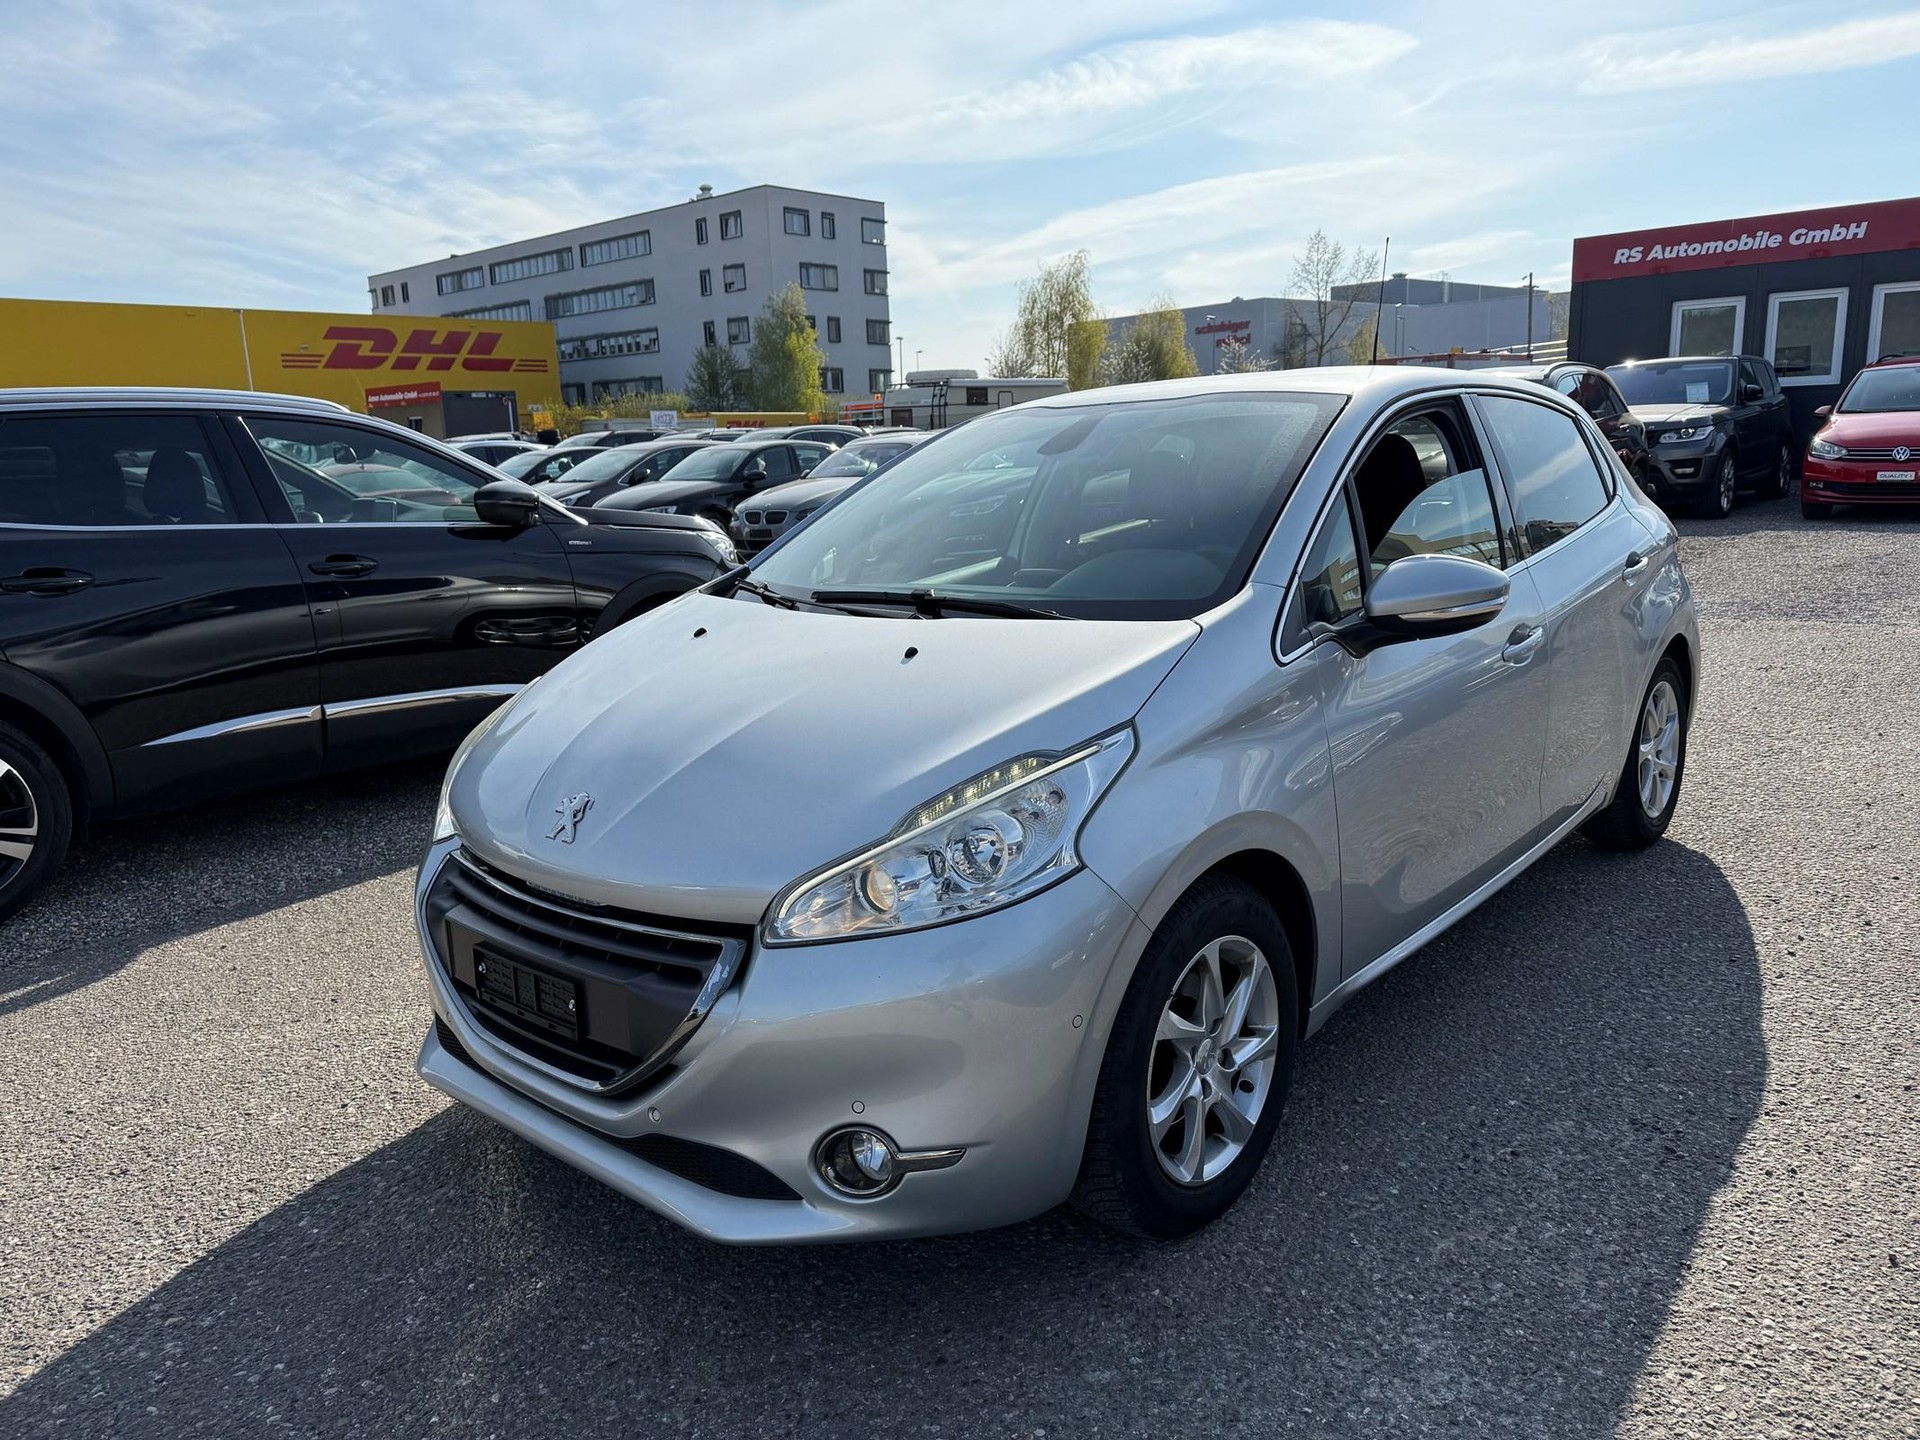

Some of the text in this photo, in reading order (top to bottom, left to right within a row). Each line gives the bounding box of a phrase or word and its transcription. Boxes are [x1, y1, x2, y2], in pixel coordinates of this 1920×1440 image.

[1613, 221, 1869, 265] RS Automobile GmbH
[322, 326, 516, 372] DHL
